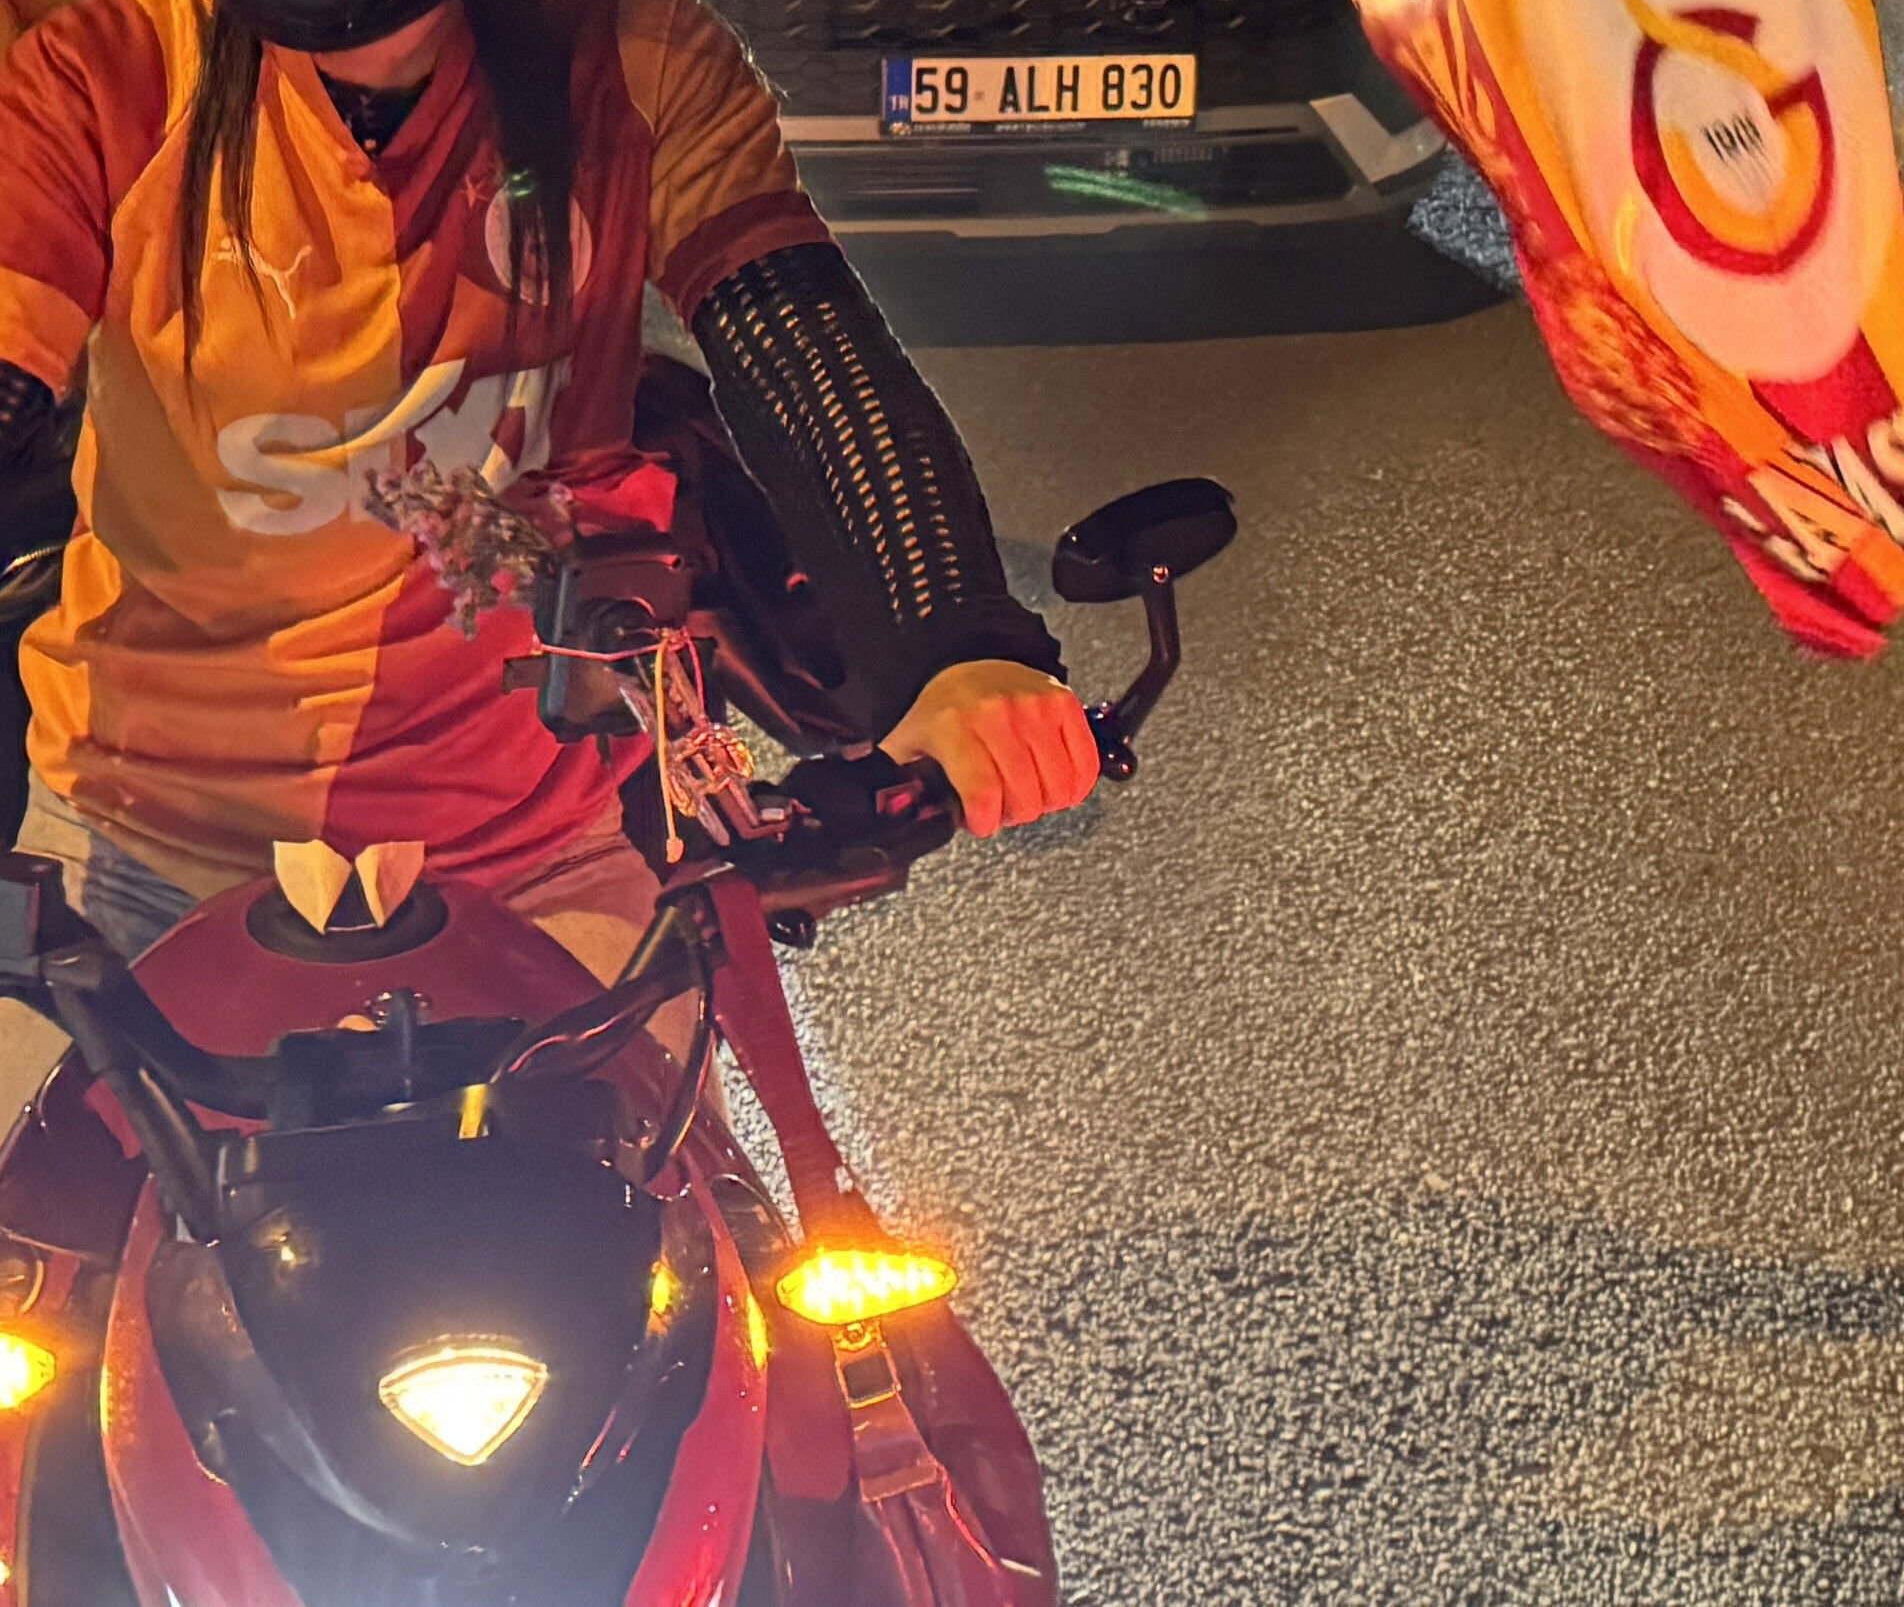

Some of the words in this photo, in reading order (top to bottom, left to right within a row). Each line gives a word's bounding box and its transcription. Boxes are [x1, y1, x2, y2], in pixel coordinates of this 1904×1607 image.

[915, 66, 969, 114] 59
[998, 65, 1080, 113] ALH
[1101, 63, 1182, 111] 830
